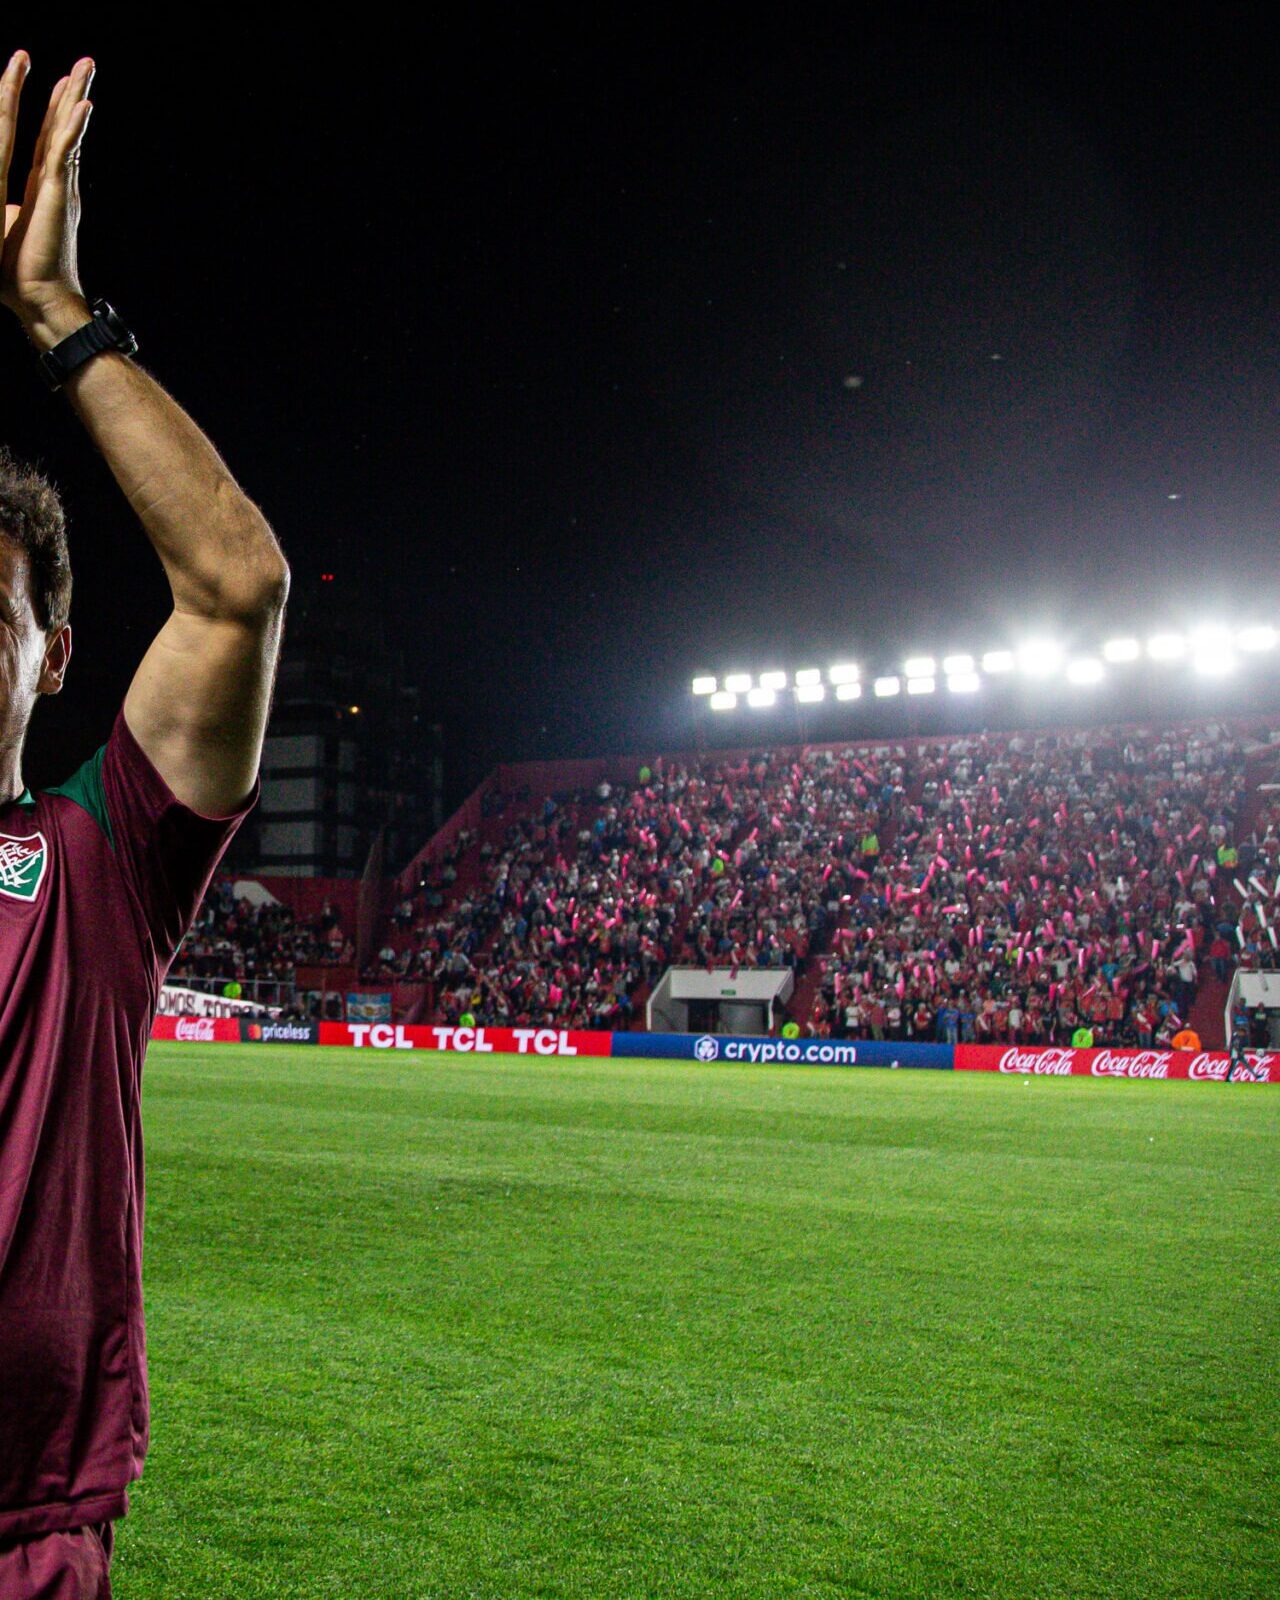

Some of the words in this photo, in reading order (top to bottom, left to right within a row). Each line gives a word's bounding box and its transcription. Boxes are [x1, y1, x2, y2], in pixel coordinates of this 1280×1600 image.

[175, 1018, 215, 1041] Coca-Cola
[262, 1023, 312, 1041] priceless
[347, 1024, 414, 1049] TCL
[432, 1027, 494, 1053] TCL
[512, 1029, 578, 1056] TCL
[724, 1041, 857, 1063] crypto.com
[999, 1047, 1077, 1076] Coca-Cola
[1091, 1050, 1173, 1078] Coca-Cola
